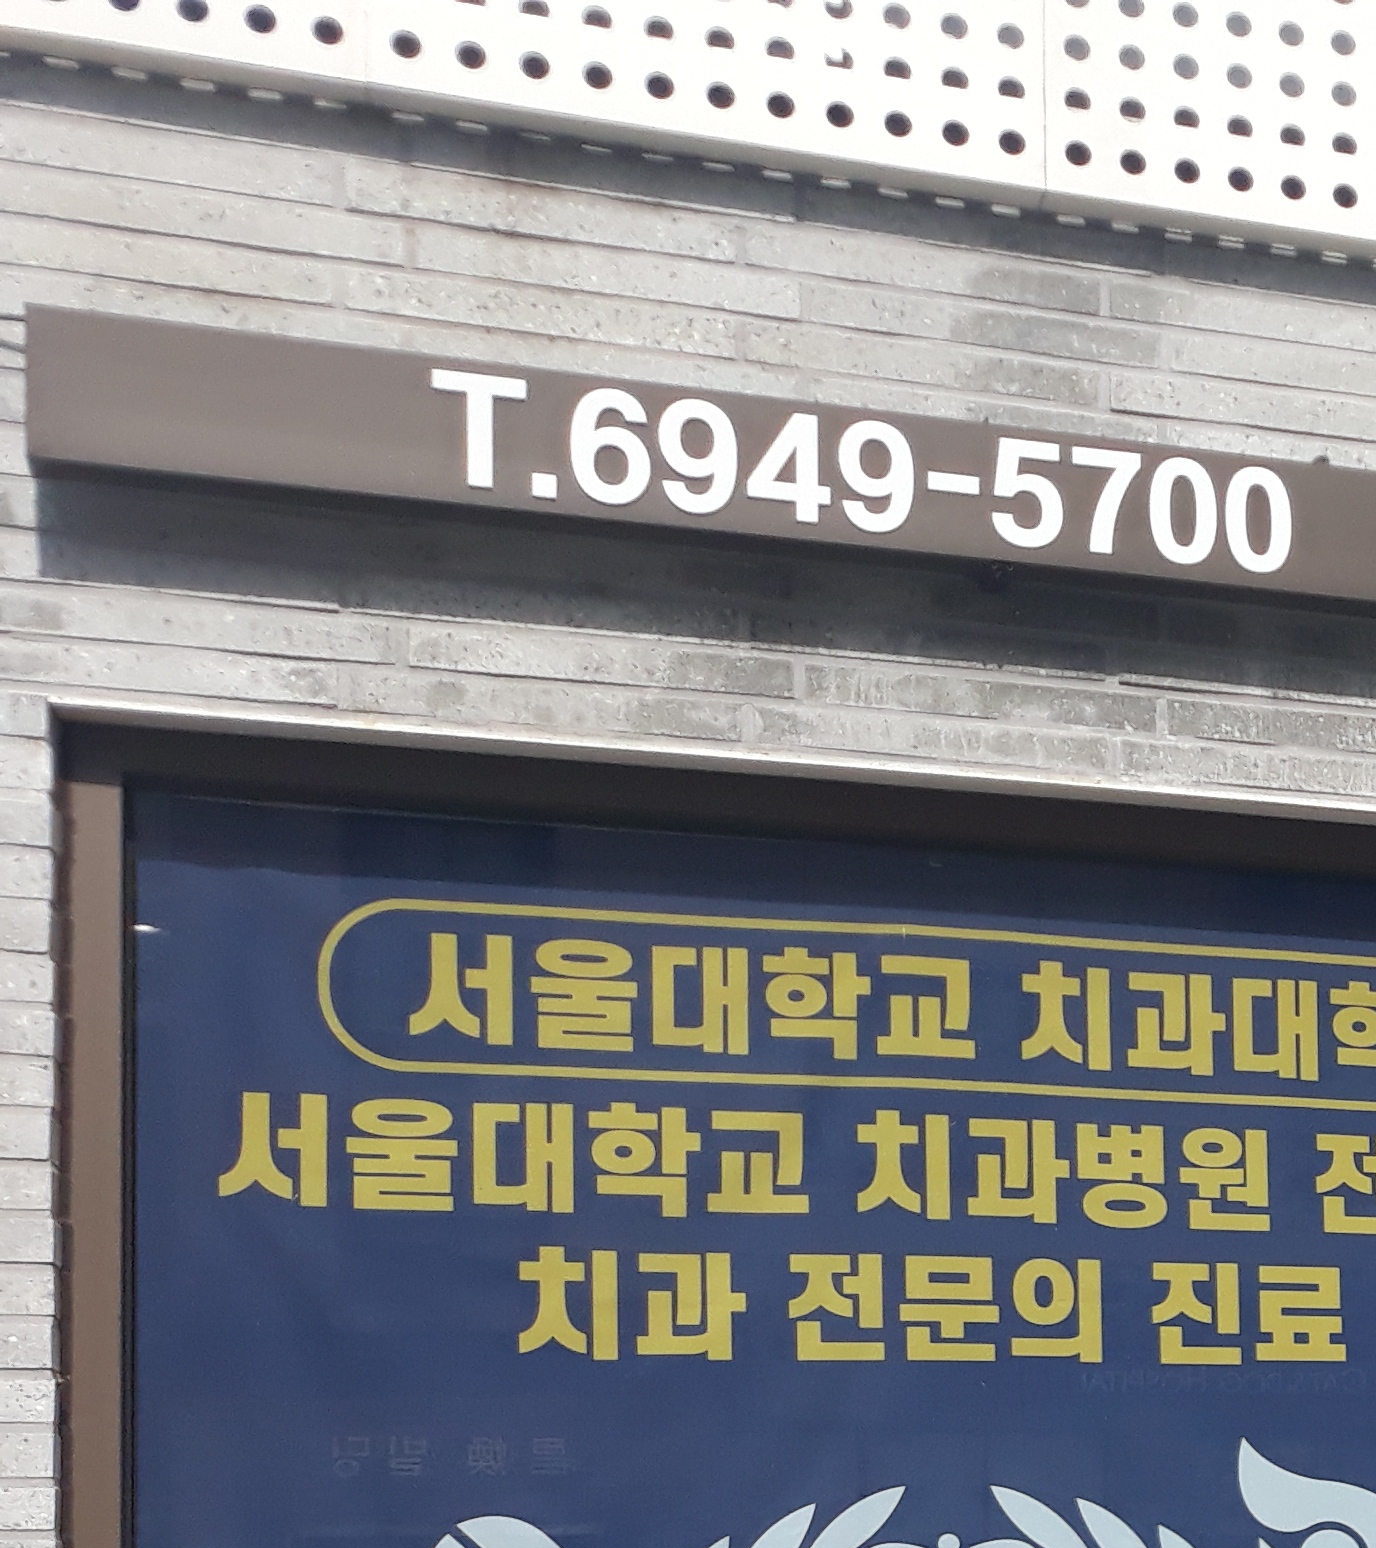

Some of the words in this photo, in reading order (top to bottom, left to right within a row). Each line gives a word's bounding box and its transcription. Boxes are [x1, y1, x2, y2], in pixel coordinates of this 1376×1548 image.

[429, 367, 1294, 575] T.6949-5700
[408, 931, 978, 1061] 서울대학교
[216, 1090, 811, 1219] 서울대학교
[855, 1108, 1272, 1234] 치과병원
[517, 1244, 748, 1362] 치과
[786, 1252, 1105, 1365] 전문의
[1150, 1259, 1349, 1366] 진료
